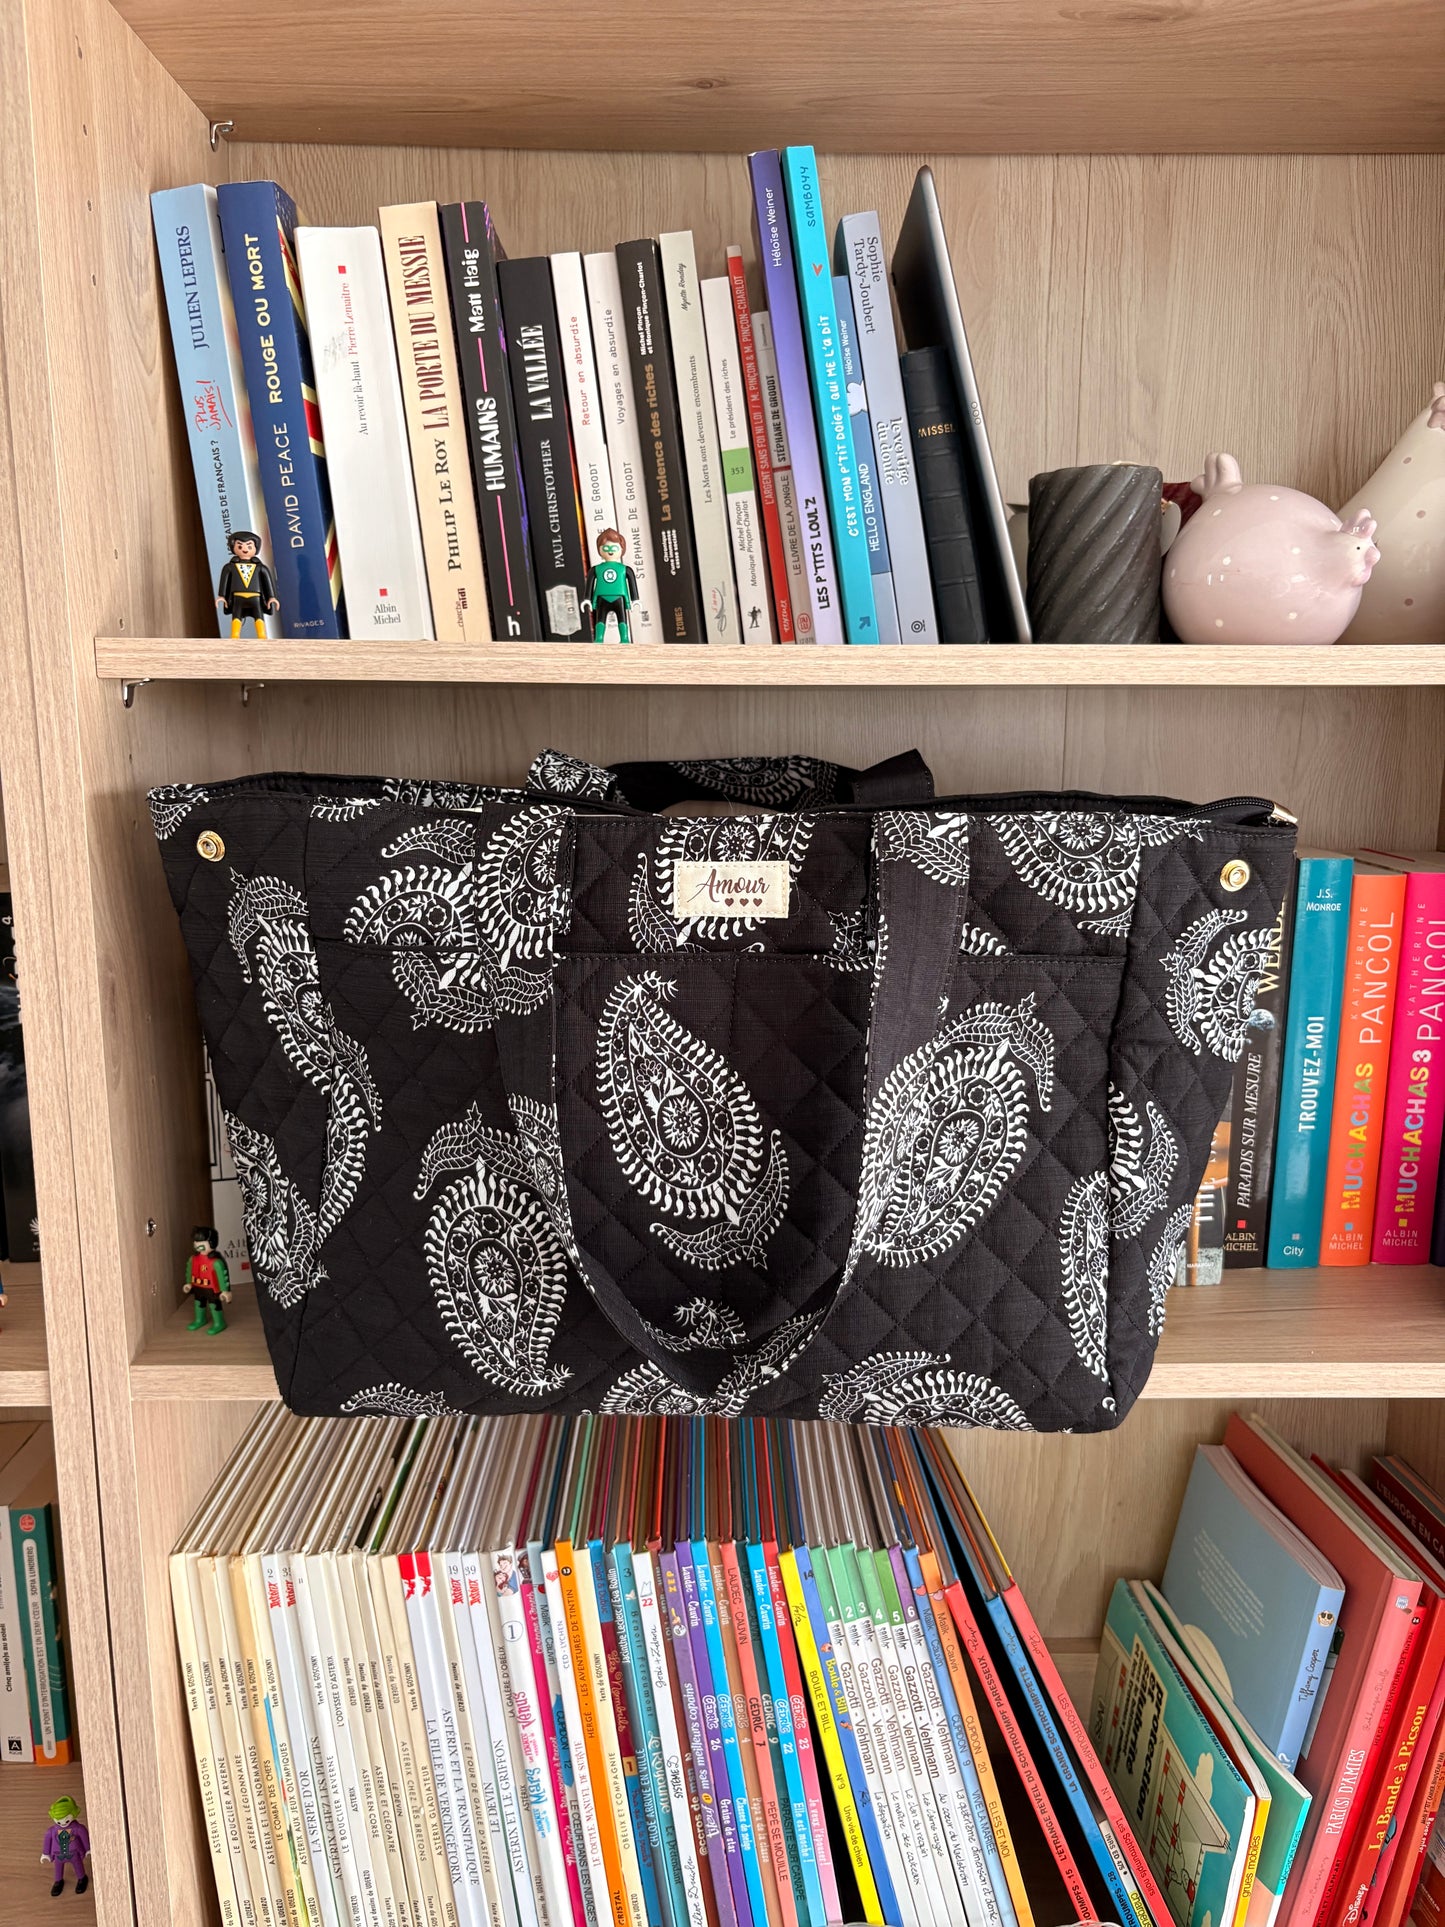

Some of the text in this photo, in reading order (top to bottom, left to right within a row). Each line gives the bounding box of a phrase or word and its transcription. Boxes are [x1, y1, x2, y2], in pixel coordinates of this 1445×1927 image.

[765, 187, 782, 266] Héloïse Weiner
[176, 226, 209, 349] JULIEN LEPERS
[853, 239, 875, 334] Tardy-Joubert
[867, 237, 882, 282] Sophie
[245, 233, 305, 548] DAVID PEACE ROUGE OU MORT
[347, 326, 366, 420] revoir là-haut Pierre
[462, 249, 506, 491] HUMAINS Matt Haig
[516, 325, 549, 393] VALLÉE
[643, 363, 658, 408] riches
[733, 274, 775, 504] L'ARGENT SANS PINÇON PINÇON-CHARLOT
[398, 235, 462, 571] PHILIP ROY LA PORTE DU MESSIE
[529, 396, 552, 420] LA
[570, 316, 601, 501] GROODT Retour en absurdie
[651, 411, 661, 437] des
[688, 355, 707, 461] sont devenus encombrants
[725, 394, 736, 428] président
[212, 447, 227, 506] DE FRANÇAIS
[604, 309, 645, 579] STÉPHANE GROODT Voyages en absurdie
[651, 441, 669, 500] violence
[766, 375, 800, 562] LIVRE JONGLE STÉPHANE GROODT
[824, 361, 859, 536] C'EST MON ME
[880, 443, 895, 484] doute
[894, 433, 910, 485] vertige
[540, 439, 561, 532] CHRISTOPHER
[662, 505, 672, 521] La
[859, 463, 880, 551] HELLO ENGLAND
[554, 535, 565, 568] PAUL
[805, 497, 830, 609] LES P'TITS LOUL'Z
[687, 869, 770, 902] Amour
[1316, 888, 1333, 898] J.S.
[1351, 906, 1367, 1019] KATHERINE
[1359, 912, 1395, 1043] PANCOL
[1407, 903, 1425, 1016] KATHERINE
[1298, 1015, 1325, 1132] TROUVEZ-MOI
[1237, 1053, 1262, 1208] PARADIS SUR MESURE
[1341, 1063, 1373, 1209] MUCHACHAS
[1394, 1049, 1431, 1212] MUCHACHAS 3
[1222, 1242, 1258, 1251] MICHEL
[1225, 1232, 1255, 1241] ALBIN
[1283, 1246, 1304, 1256] City
[1329, 1242, 1363, 1250] MICHEL
[1332, 1234, 1363, 1242] ALBIN
[27, 1546, 36, 1577] LUNDBERG
[666, 1570, 677, 1592] ZEP
[608, 1568, 624, 1633] Leclerc Rollin
[643, 1598, 653, 1607] 22
[893, 1611, 900, 1621] 5
[907, 1607, 914, 1617] 6
[809, 1670, 830, 1732] BOULE ET BILL
[1298, 1649, 1321, 1701] Tiffany Cooper
[1387, 1666, 1403, 1702] AVENTURES
[583, 1711, 595, 1738] HERGÉ
[683, 1683, 709, 1788] mes meilleurs copains
[799, 1738, 809, 1749] 23
[840, 1662, 876, 1774] Gazzotti Vehlmann
[871, 1658, 908, 1771] Gazzotti Vehlmann
[905, 1666, 941, 1778] Gazzotti Vehlmann
[945, 1644, 1002, 1829] Cauvin 20 ELLES
[979, 1656, 1004, 1707] PARESSEUX
[999, 1709, 1028, 1767] SCHTROUMPF
[1019, 1665, 1073, 1779] GRANDE SCHTROUMPFETTE
[249, 1746, 263, 1796] NORMANDS
[311, 1736, 325, 1775] PICTES
[431, 1737, 441, 1769] FILLE
[493, 1739, 511, 1790] GRIFFON
[1137, 1681, 1163, 1821] protection
[1368, 1705, 1427, 1850] La Bande à Picsou
[200, 1757, 222, 1853] ASTÉRIX LES GOTHS
[219, 1757, 239, 1841] BOUCLIER ARVERNE
[264, 1759, 281, 1829] COMBAT CHEFS
[299, 1769, 321, 1853] LA SERPE D'OR
[483, 1782, 498, 1816] DEVIN
[525, 1767, 547, 1805] Mars
[1325, 1749, 1365, 1834] PARI(S) D'AMIES
[773, 1842, 787, 1881] MOUILLE
[843, 1805, 864, 1867] Une chien
[1122, 1833, 1156, 1896] Schtroumpfs noirs
[1241, 1836, 1260, 1897] grues mobiles
